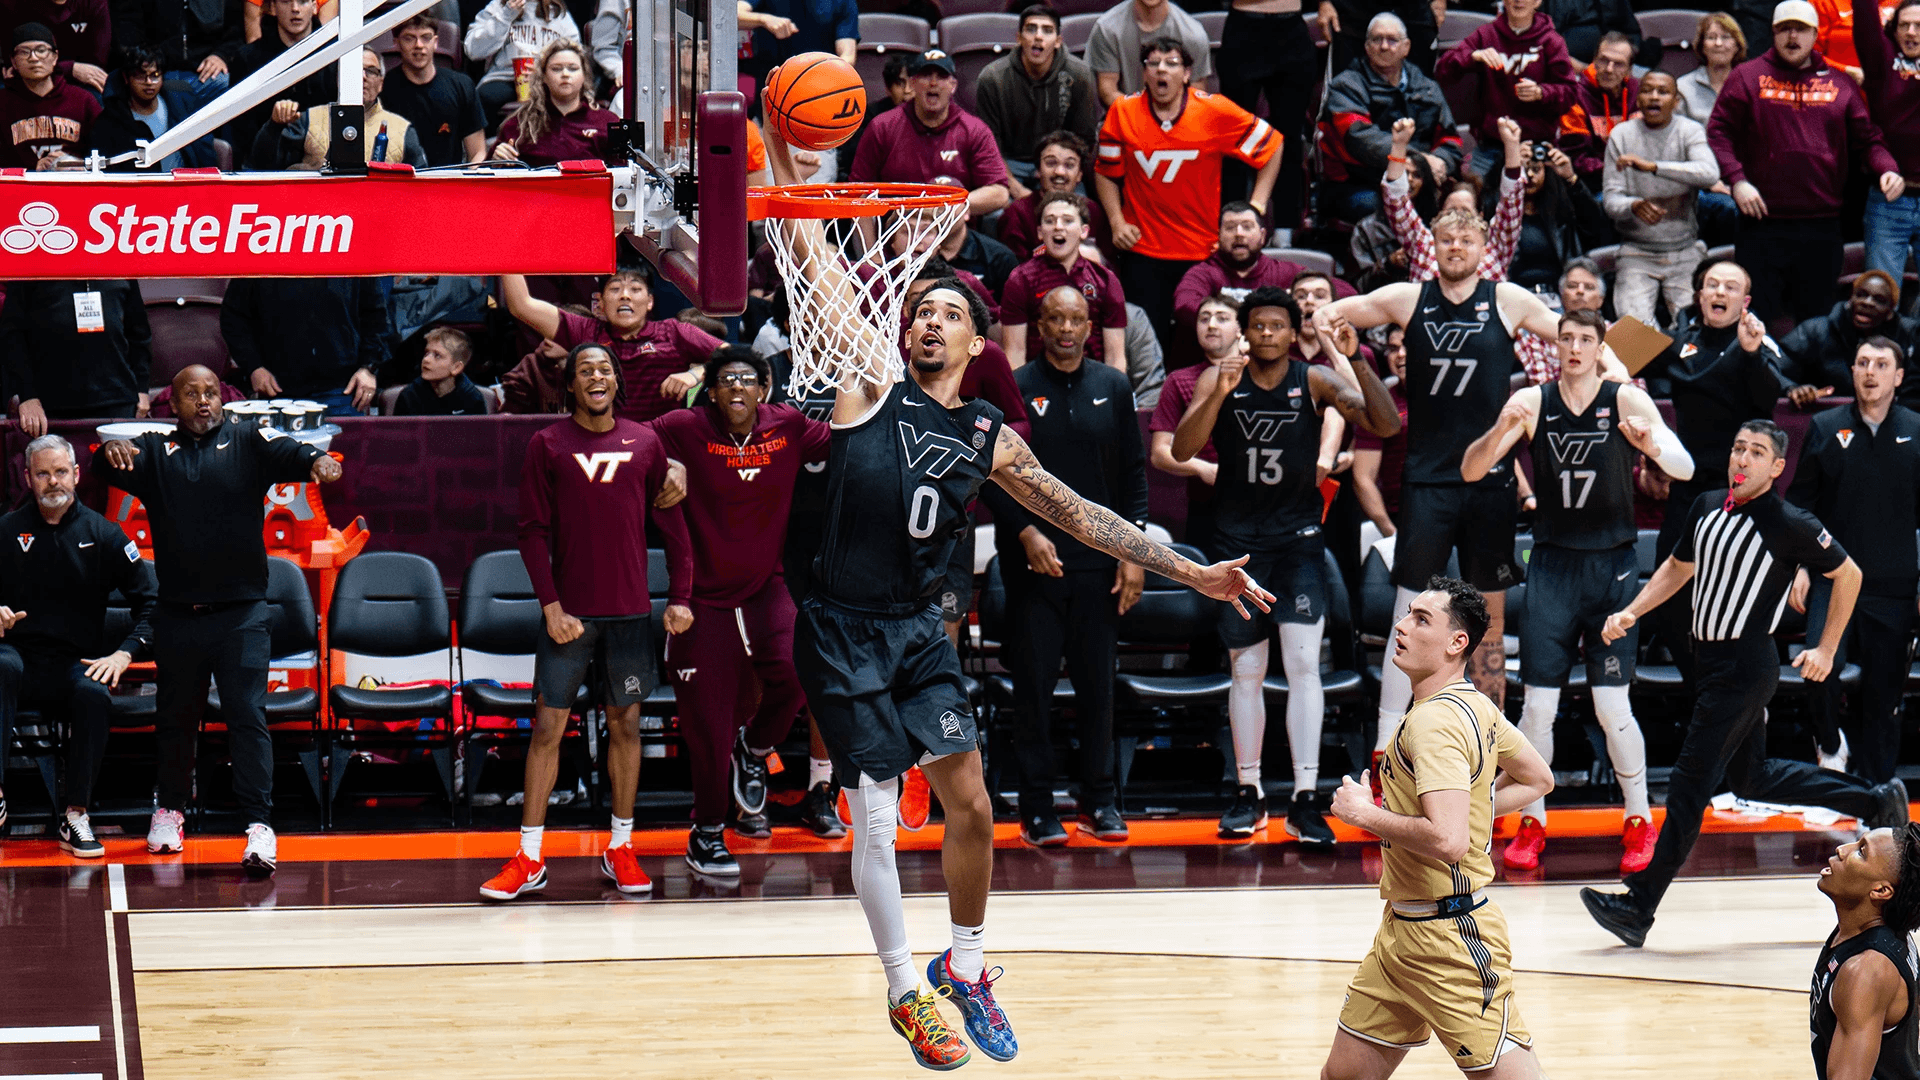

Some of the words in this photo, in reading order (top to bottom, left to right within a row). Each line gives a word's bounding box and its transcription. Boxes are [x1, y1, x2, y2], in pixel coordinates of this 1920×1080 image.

[831, 97, 861, 120] VT
[1134, 150, 1199, 183] VT
[1424, 322, 1485, 353] VT
[1429, 357, 1478, 397] 77
[1234, 410, 1298, 442] VT
[726, 453, 772, 468] HOKIES
[757, 436, 788, 454] TECH
[899, 421, 979, 479] VT
[1547, 432, 1609, 465] VT
[573, 452, 634, 483] VT
[737, 468, 761, 481] VT
[1247, 448, 1284, 486] 13
[1559, 470, 1597, 509] 17
[908, 485, 940, 539] 0
[676, 668, 697, 681] VT
